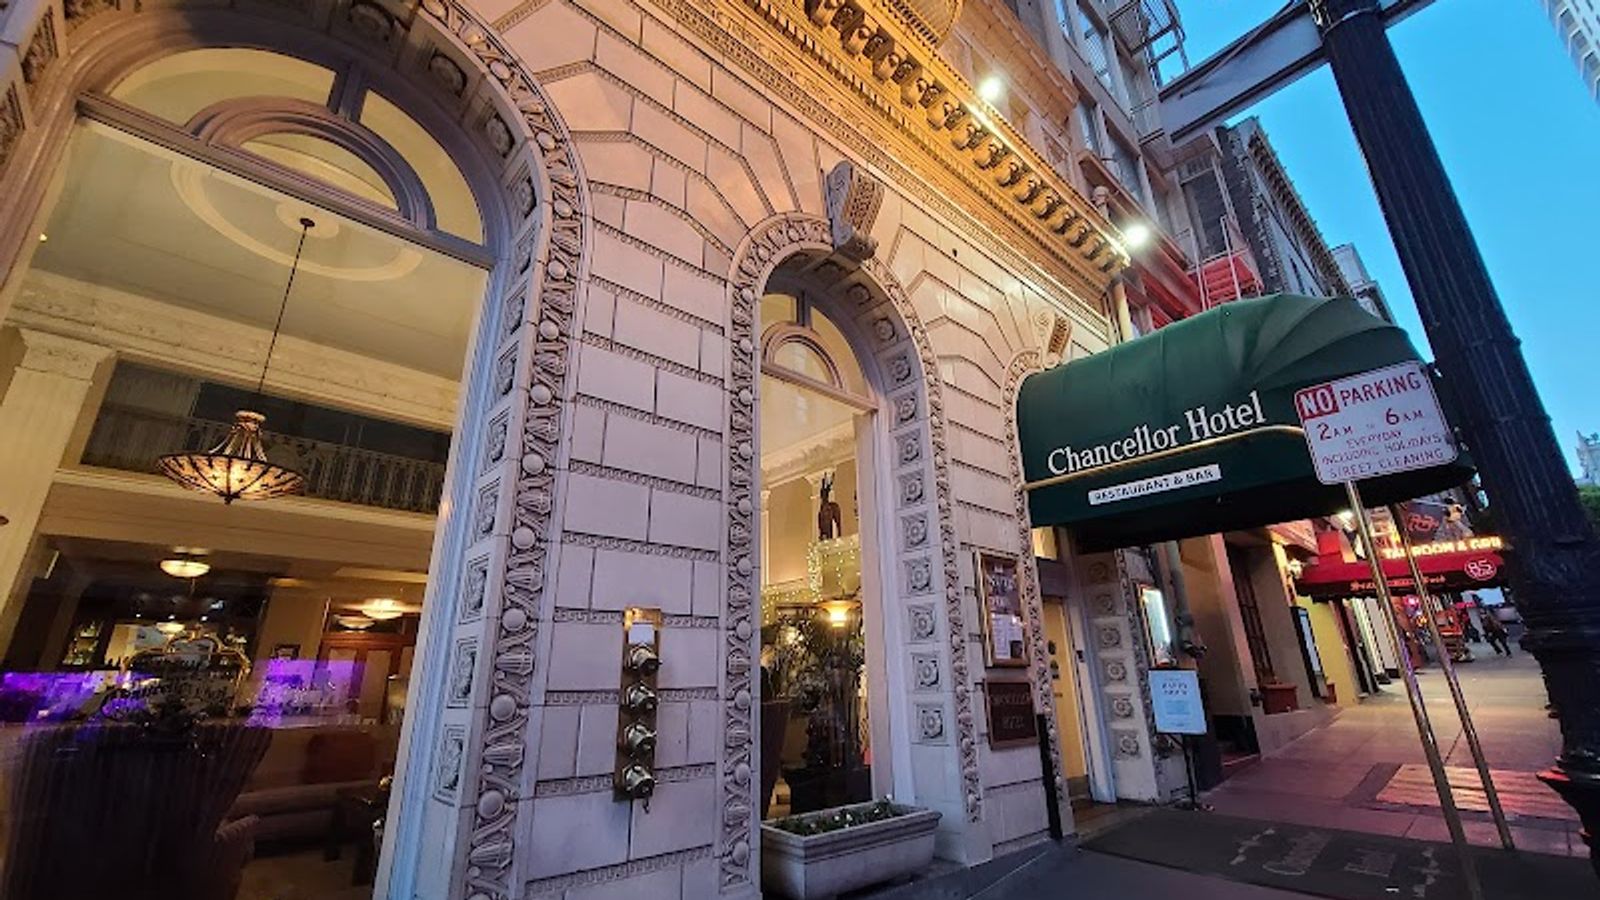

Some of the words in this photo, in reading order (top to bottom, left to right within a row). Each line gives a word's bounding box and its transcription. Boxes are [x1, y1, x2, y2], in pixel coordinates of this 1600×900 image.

[1299, 388, 1336, 417] NO
[1340, 372, 1422, 407] PARKING
[1048, 424, 1181, 475] Chancellor
[1184, 390, 1267, 441] Hotel
[1346, 430, 1402, 449] EVERYDAY
[1384, 433, 1442, 453] HOLIDAYS
[1329, 461, 1373, 479] STREET
[1379, 448, 1445, 470] CLEANING
[1093, 477, 1171, 501] RESTAURANT
[1173, 475, 1184, 485] &
[1186, 469, 1215, 484] BAR
[1467, 559, 1493, 575] 85
